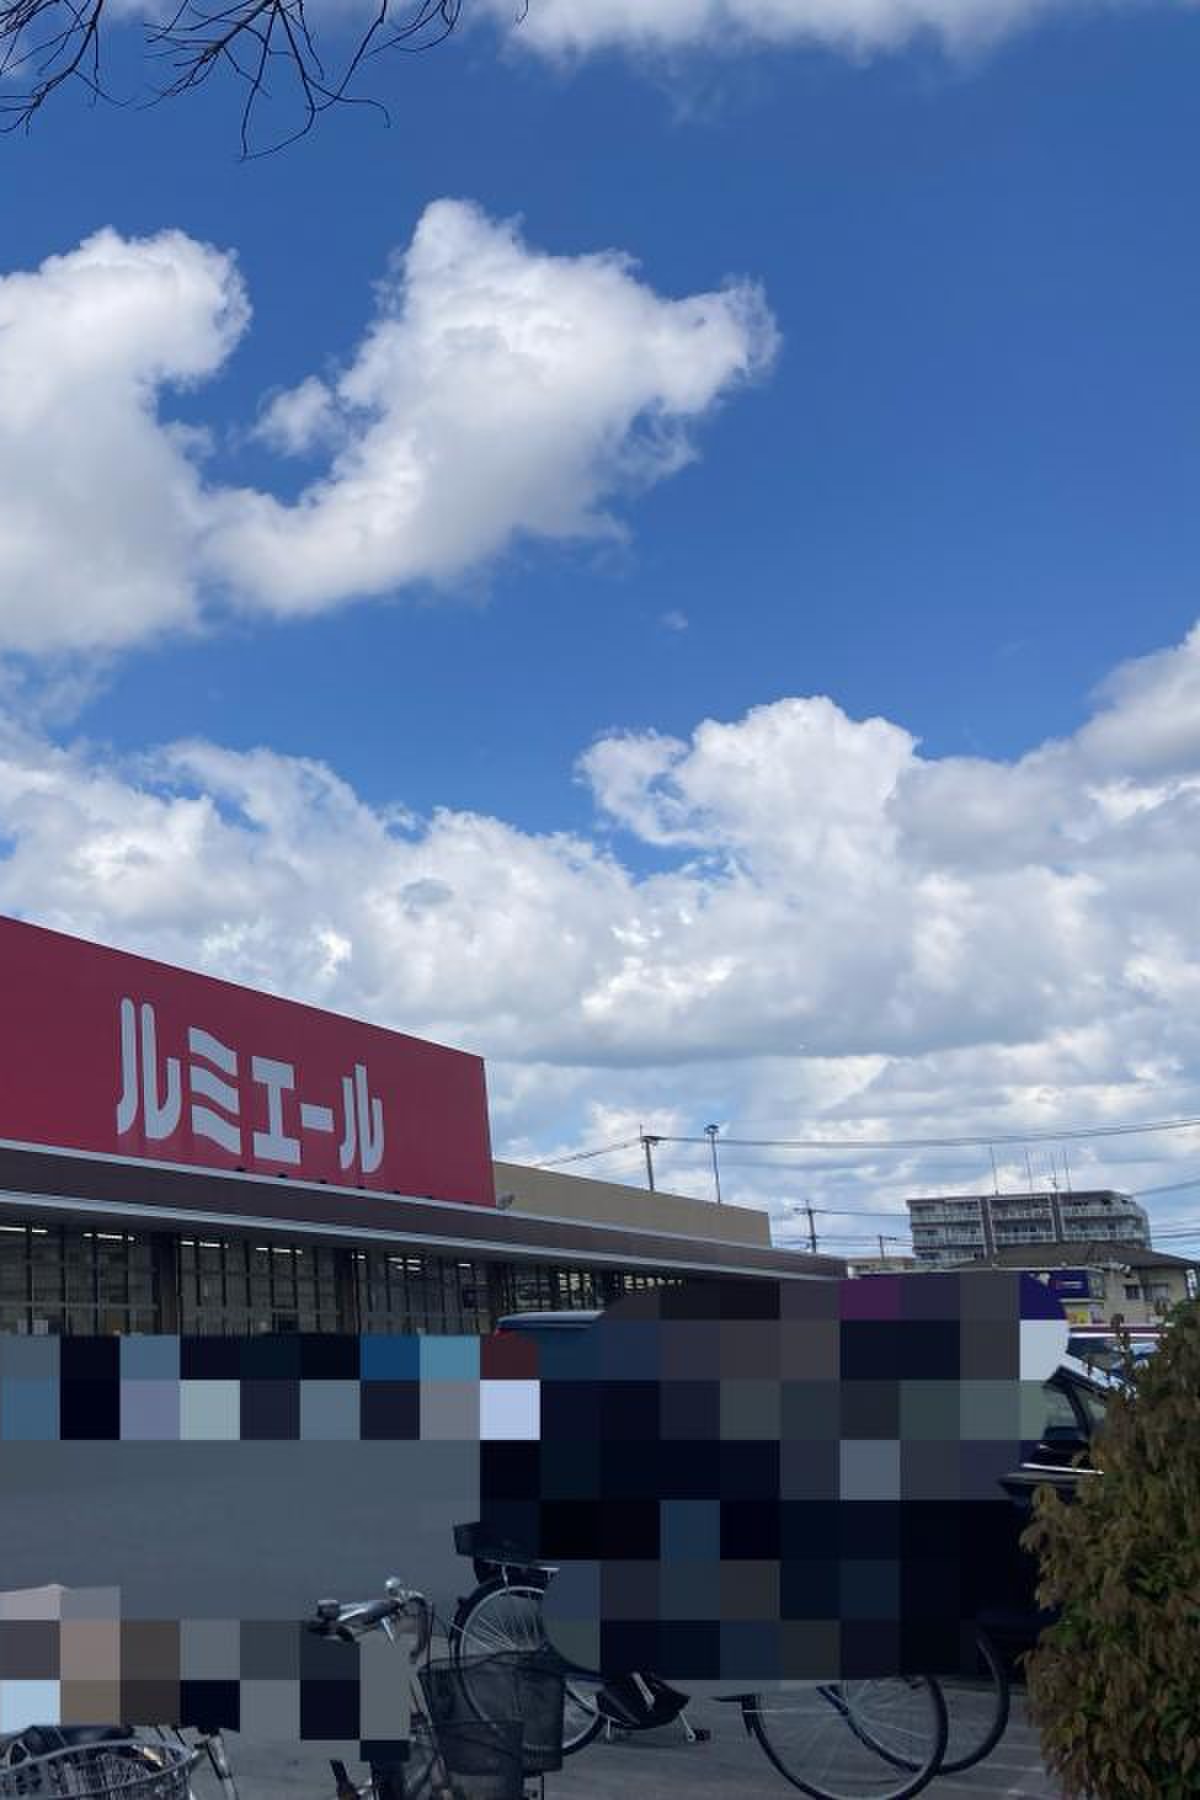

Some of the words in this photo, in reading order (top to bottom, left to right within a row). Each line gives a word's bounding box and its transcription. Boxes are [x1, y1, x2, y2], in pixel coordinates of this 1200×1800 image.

[116, 998, 385, 1174] ルミエール
